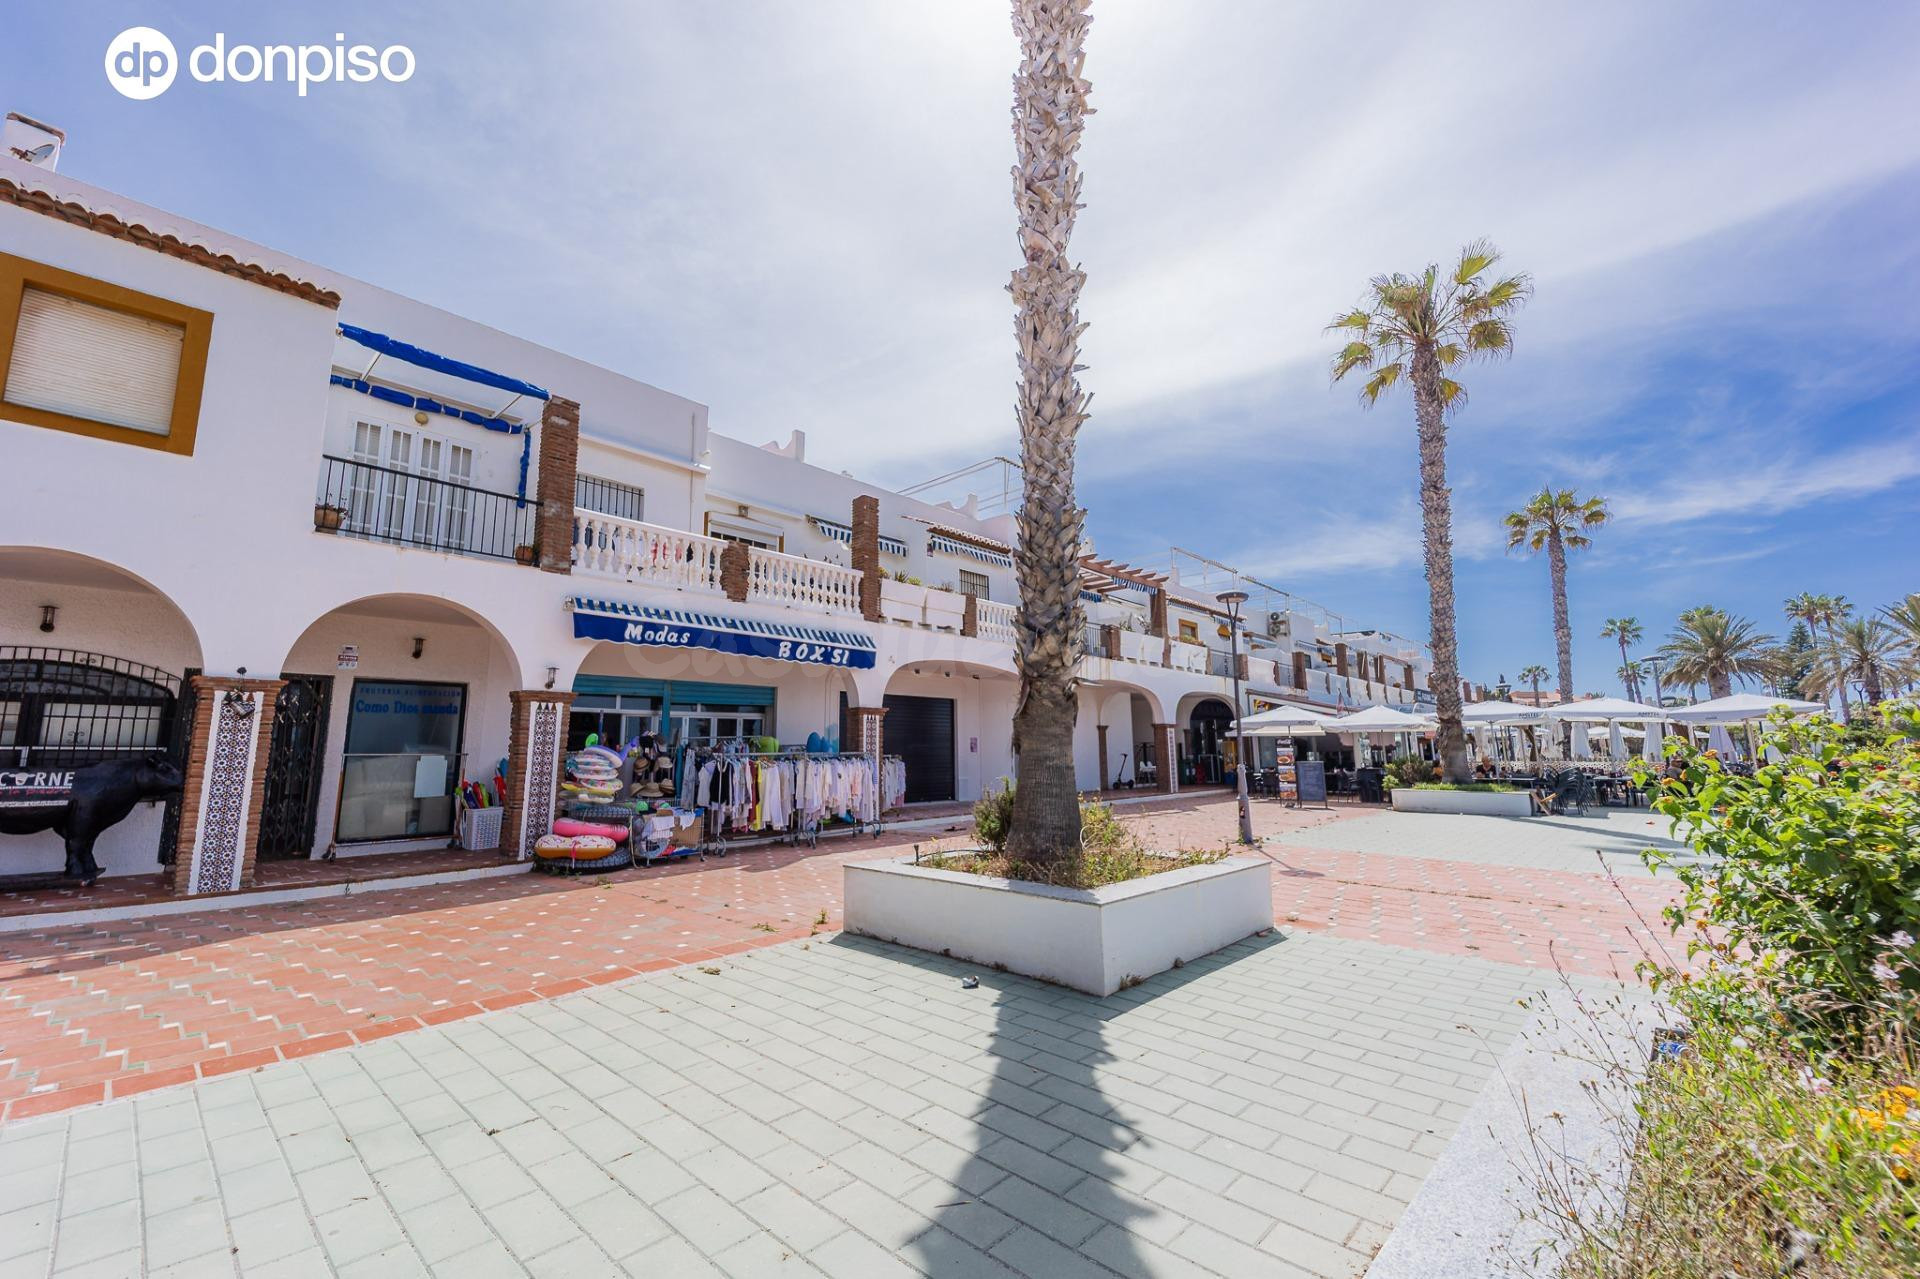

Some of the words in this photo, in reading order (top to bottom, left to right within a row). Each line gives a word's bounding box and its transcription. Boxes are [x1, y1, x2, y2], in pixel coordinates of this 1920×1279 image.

[623, 622, 691, 644] Modas
[355, 699, 389, 713] Como
[394, 700, 419, 713] Dios
[422, 702, 458, 714] manda
